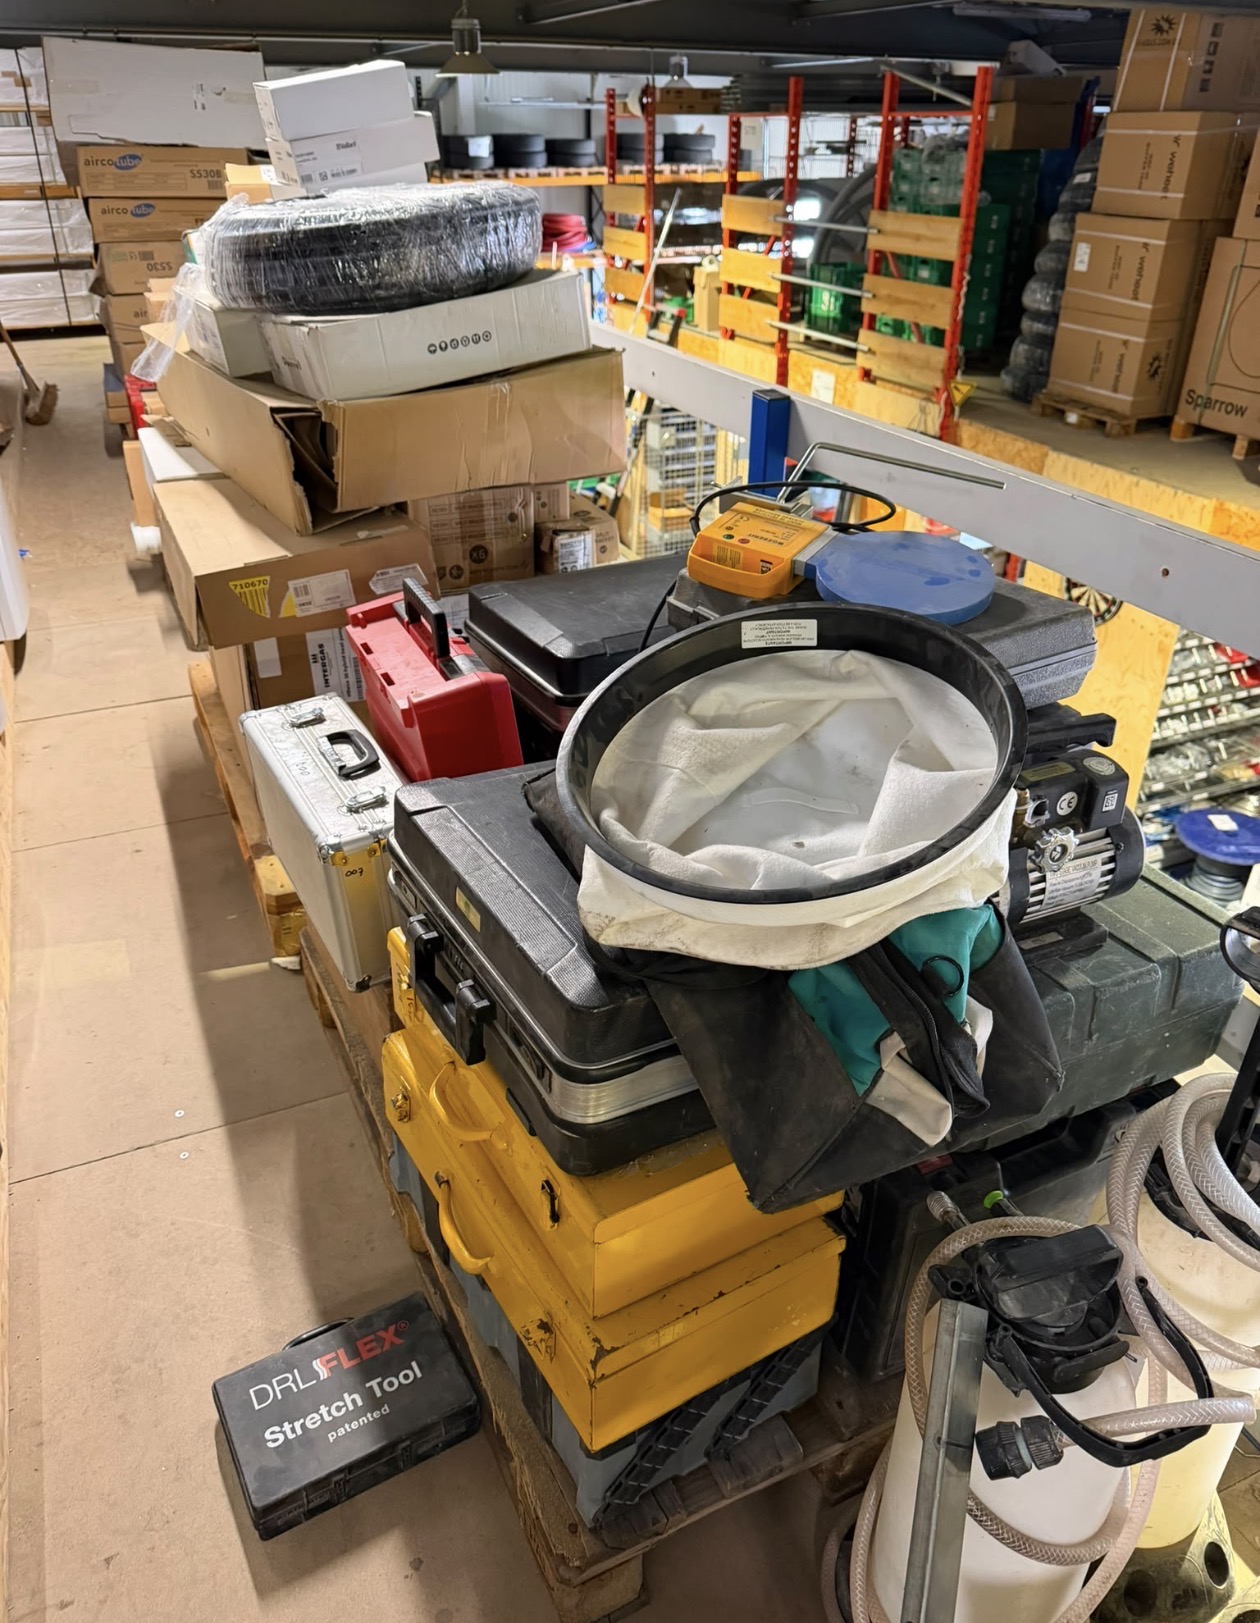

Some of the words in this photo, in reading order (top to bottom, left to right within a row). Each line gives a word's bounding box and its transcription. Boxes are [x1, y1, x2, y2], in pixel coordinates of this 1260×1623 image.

[1185, 388, 1248, 418] Sparrow
[232, 578, 269, 590] 710670
[317, 643, 330, 688] INTERGAS
[345, 867, 364, 877] 007
[263, 1392, 364, 1449] Stretch
[365, 1360, 423, 1398] Tool
[327, 1403, 391, 1443] patented
